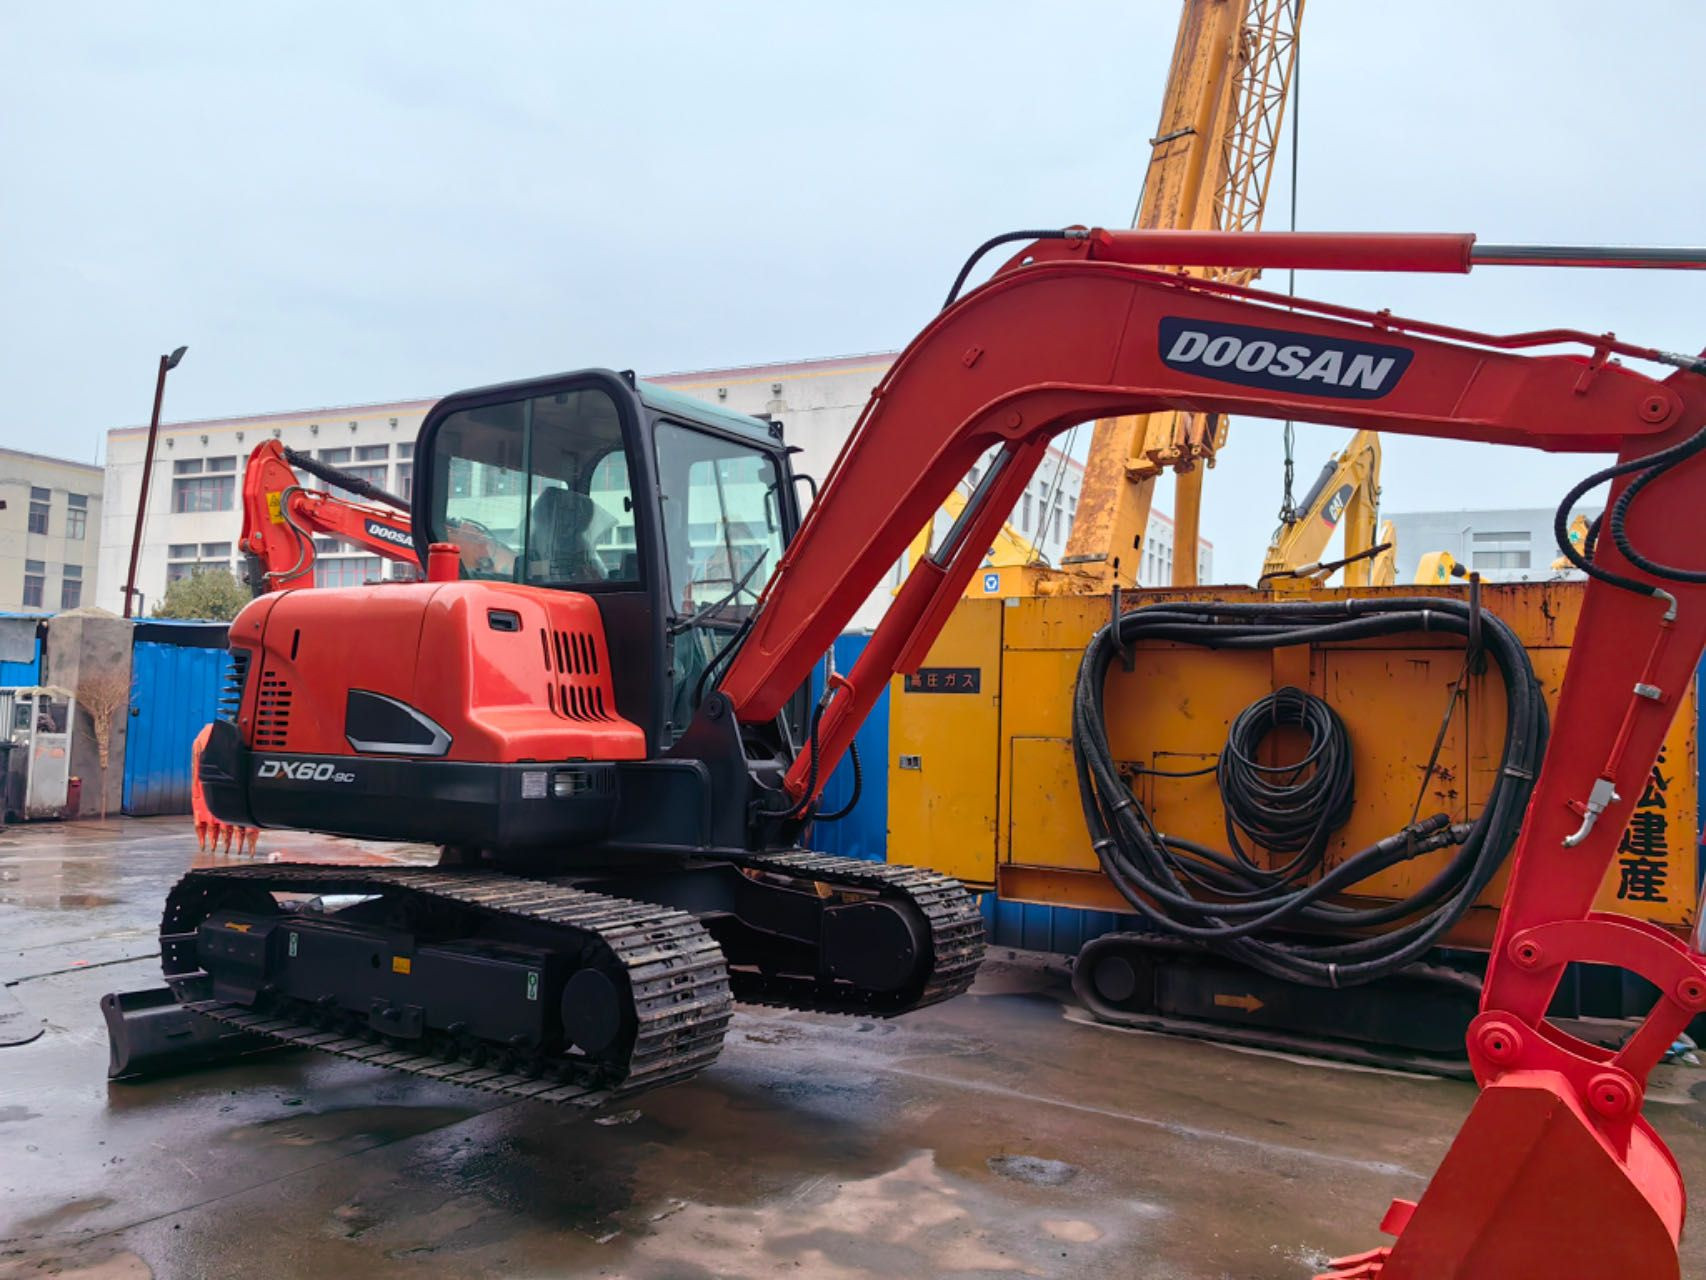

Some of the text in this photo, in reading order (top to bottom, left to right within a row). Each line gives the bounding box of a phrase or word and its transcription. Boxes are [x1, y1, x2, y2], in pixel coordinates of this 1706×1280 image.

[1166, 330, 1396, 391] DOOSAN
[1328, 491, 1344, 521] CAT
[368, 523, 414, 548] DOOSA
[1616, 744, 1670, 904] 建産
